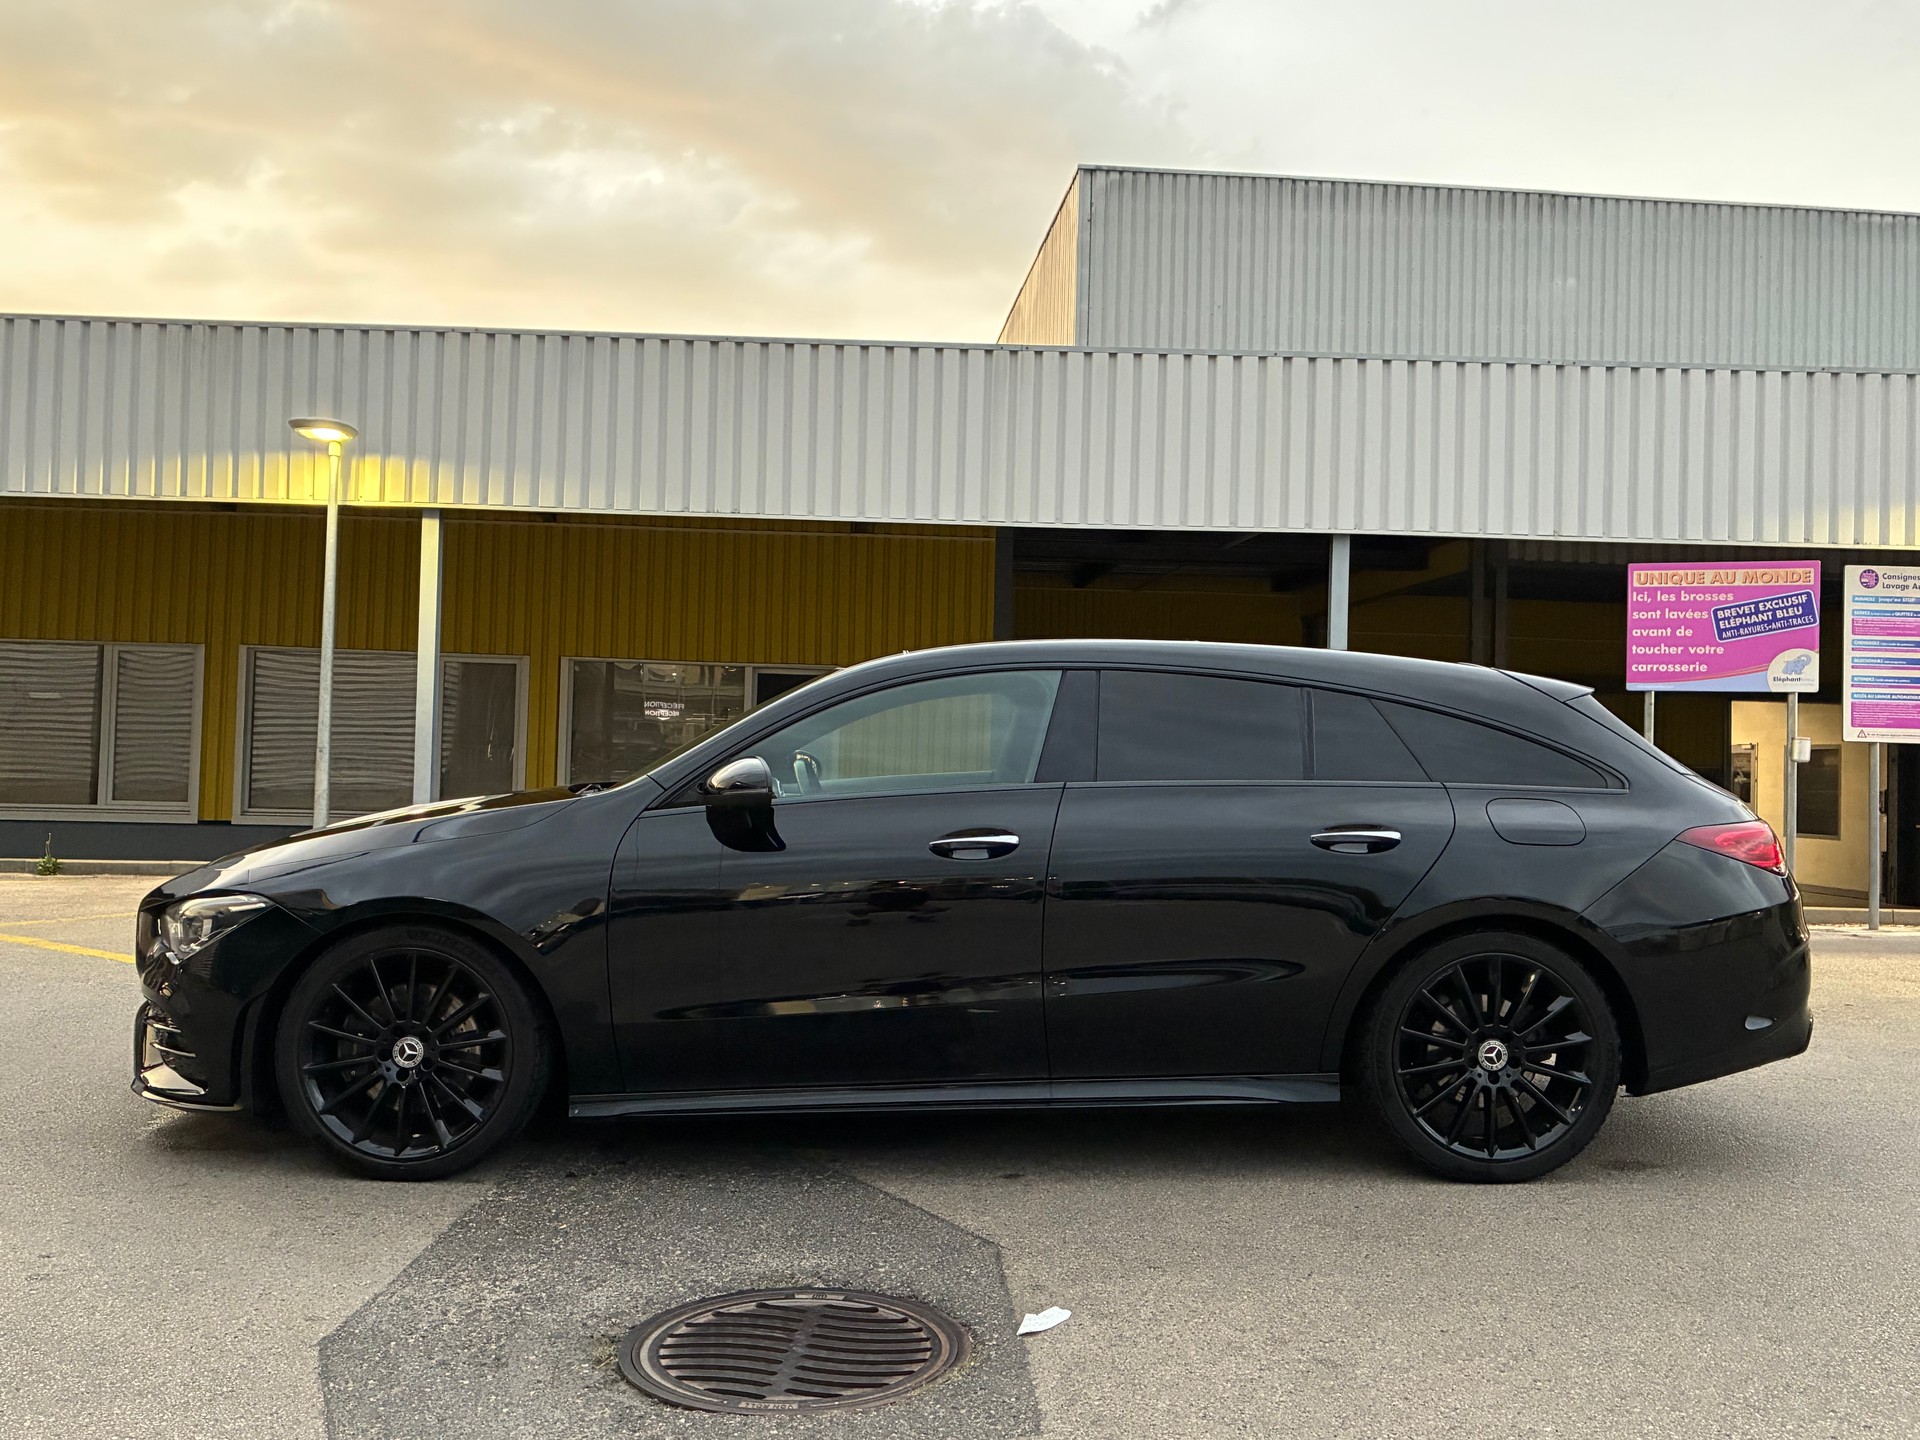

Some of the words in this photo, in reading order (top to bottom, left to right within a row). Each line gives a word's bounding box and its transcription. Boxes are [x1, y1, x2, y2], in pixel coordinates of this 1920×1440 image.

[1636, 572, 1705, 586] UNIQUE
[1710, 571, 1736, 584] AU
[1742, 569, 1811, 584] MONDE
[1882, 573, 1920, 582] Consignes
[1882, 582, 1910, 591] Lavage
[1633, 591, 1652, 603] Ici,
[1657, 591, 1676, 602] les
[1681, 591, 1734, 602] brosses
[1717, 605, 1755, 619] BREVET
[1759, 594, 1808, 611] EXCLUSIF
[1632, 609, 1661, 619] sont
[1665, 608, 1709, 619] lavées
[1776, 606, 1803, 619] BLEU
[1632, 627, 1671, 637] avant
[1676, 626, 1693, 637] de
[1632, 644, 1683, 655] toucher
[1689, 645, 1724, 655] votre
[1632, 661, 1708, 673] carrosserie
